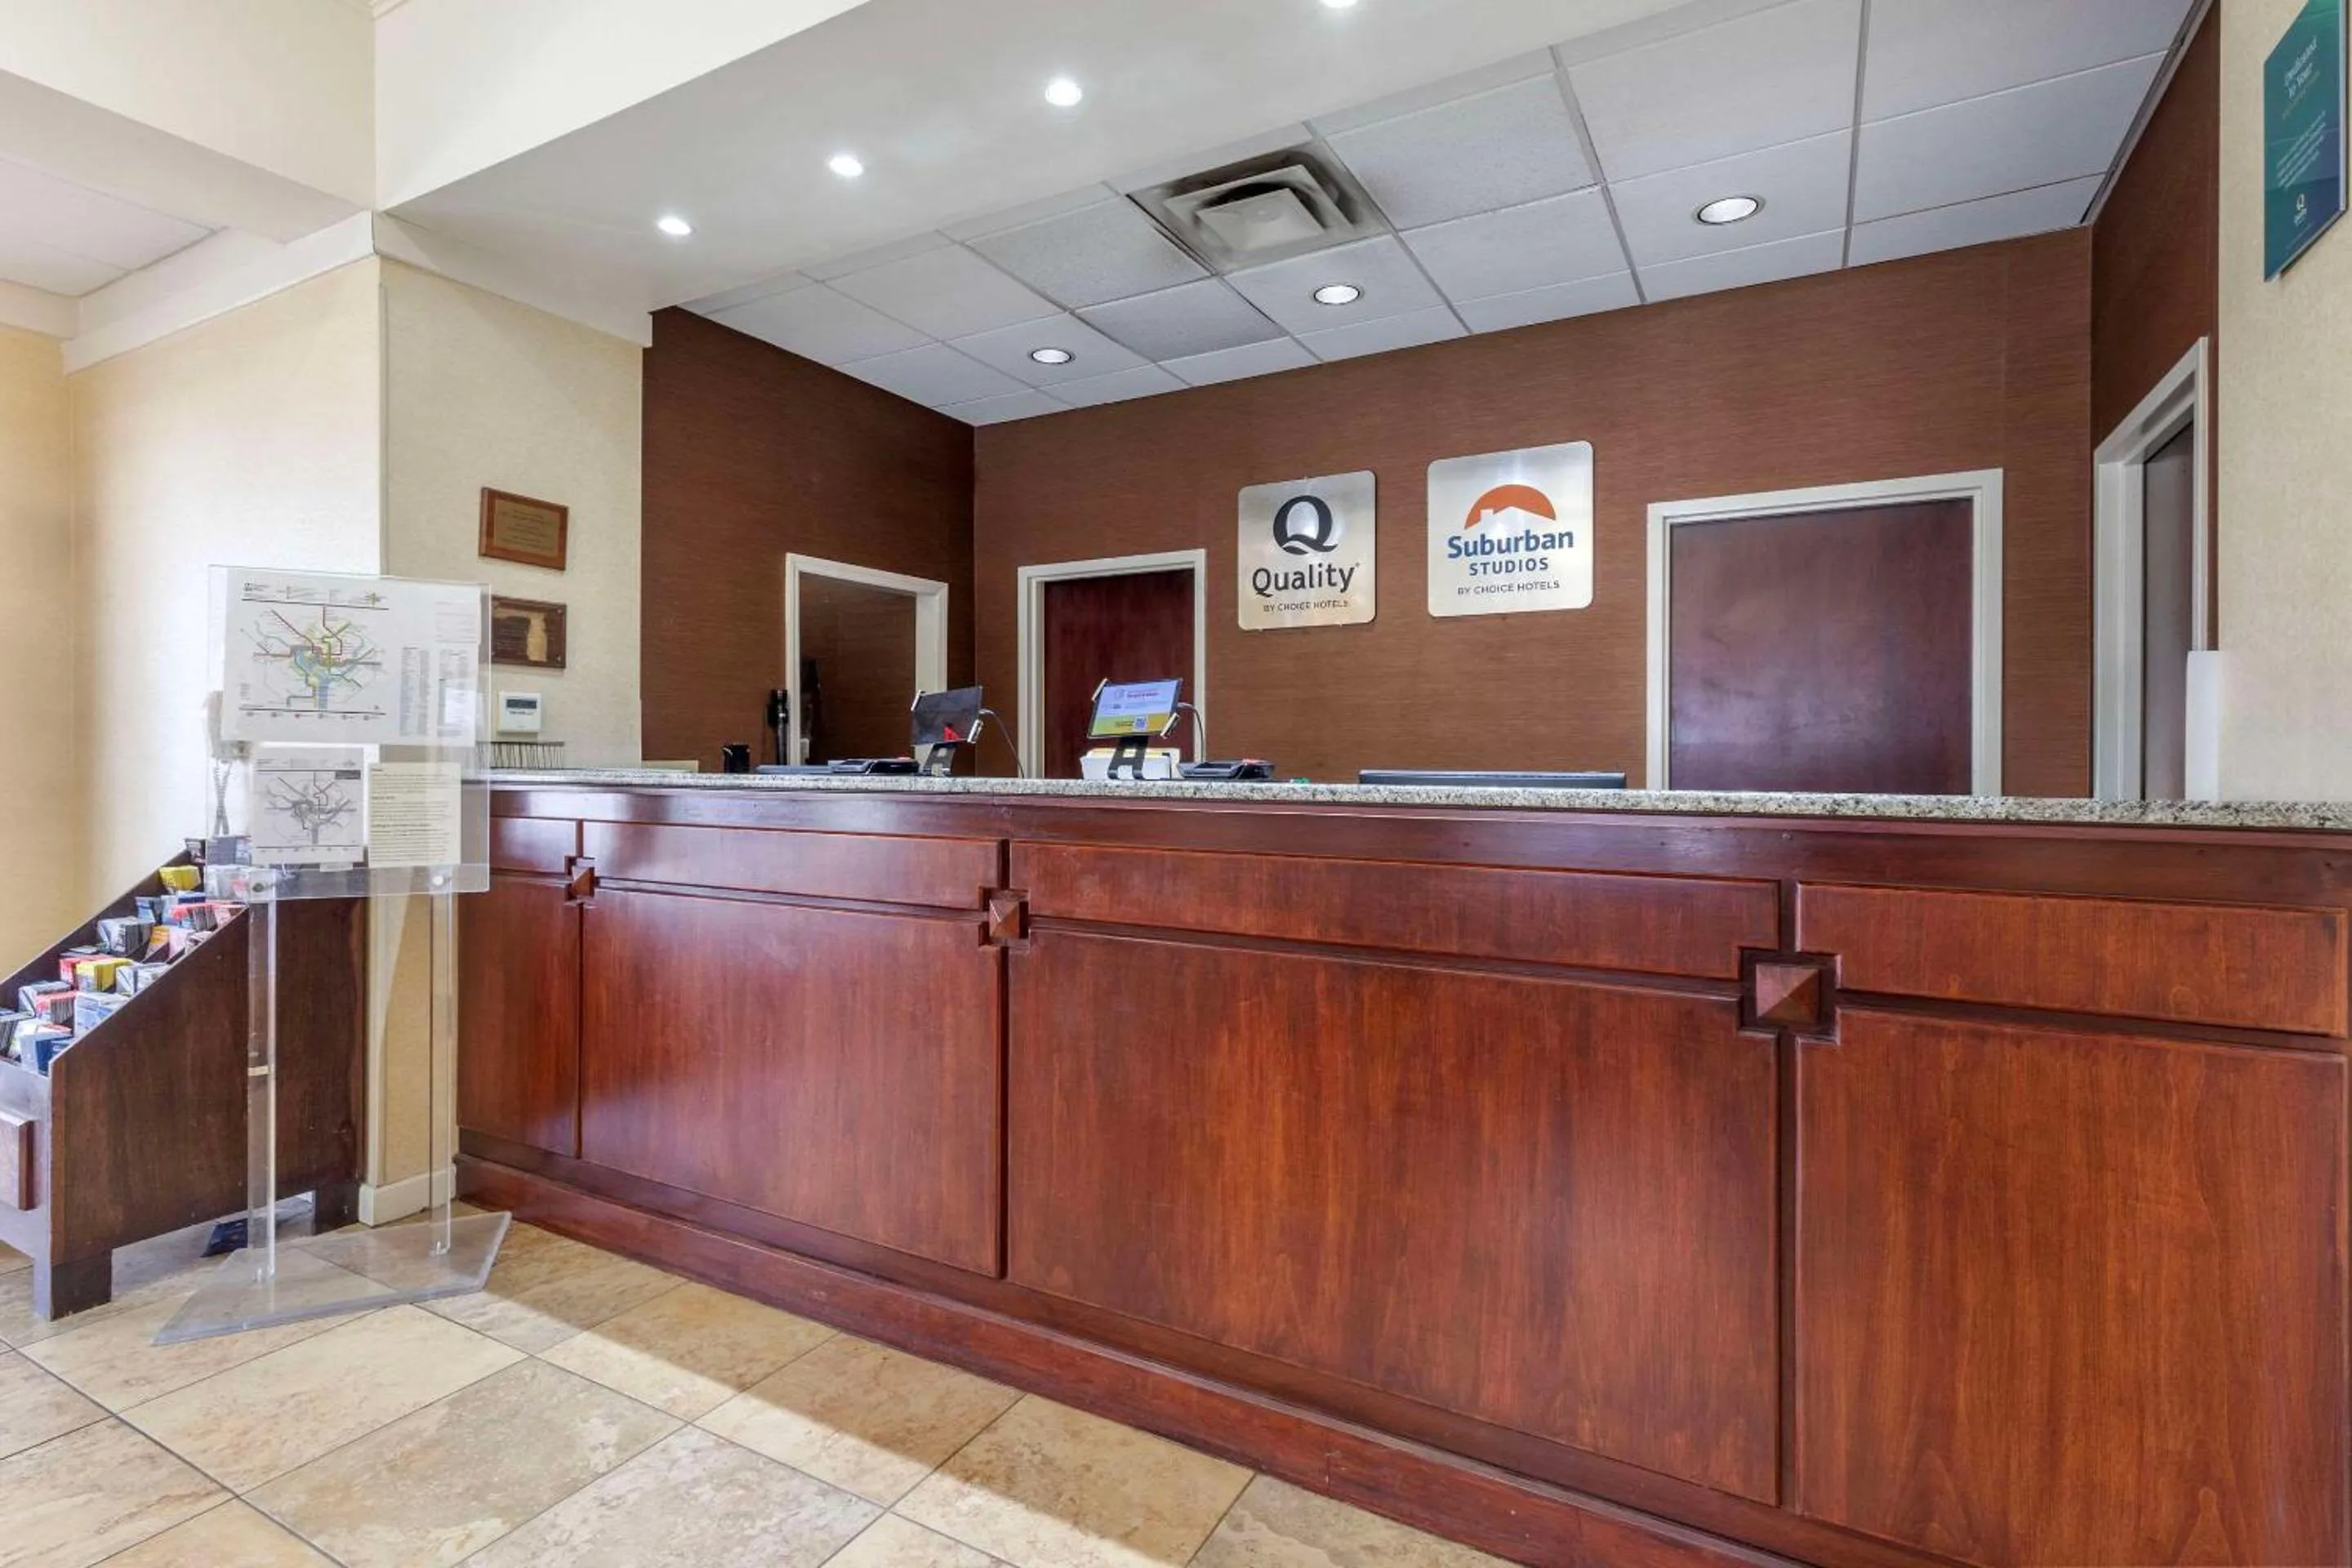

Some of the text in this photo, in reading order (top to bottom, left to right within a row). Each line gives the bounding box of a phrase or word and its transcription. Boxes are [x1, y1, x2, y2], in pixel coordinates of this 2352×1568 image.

[1273, 495, 1339, 555] Q
[1447, 529, 1574, 559] Suburban
[1469, 557, 1549, 577] STUDIOS
[1252, 562, 1356, 598] Quality
[1458, 580, 1560, 595] BY CHOICE HOTELS
[1263, 599, 1349, 612] BY CHOICE HOTELS
